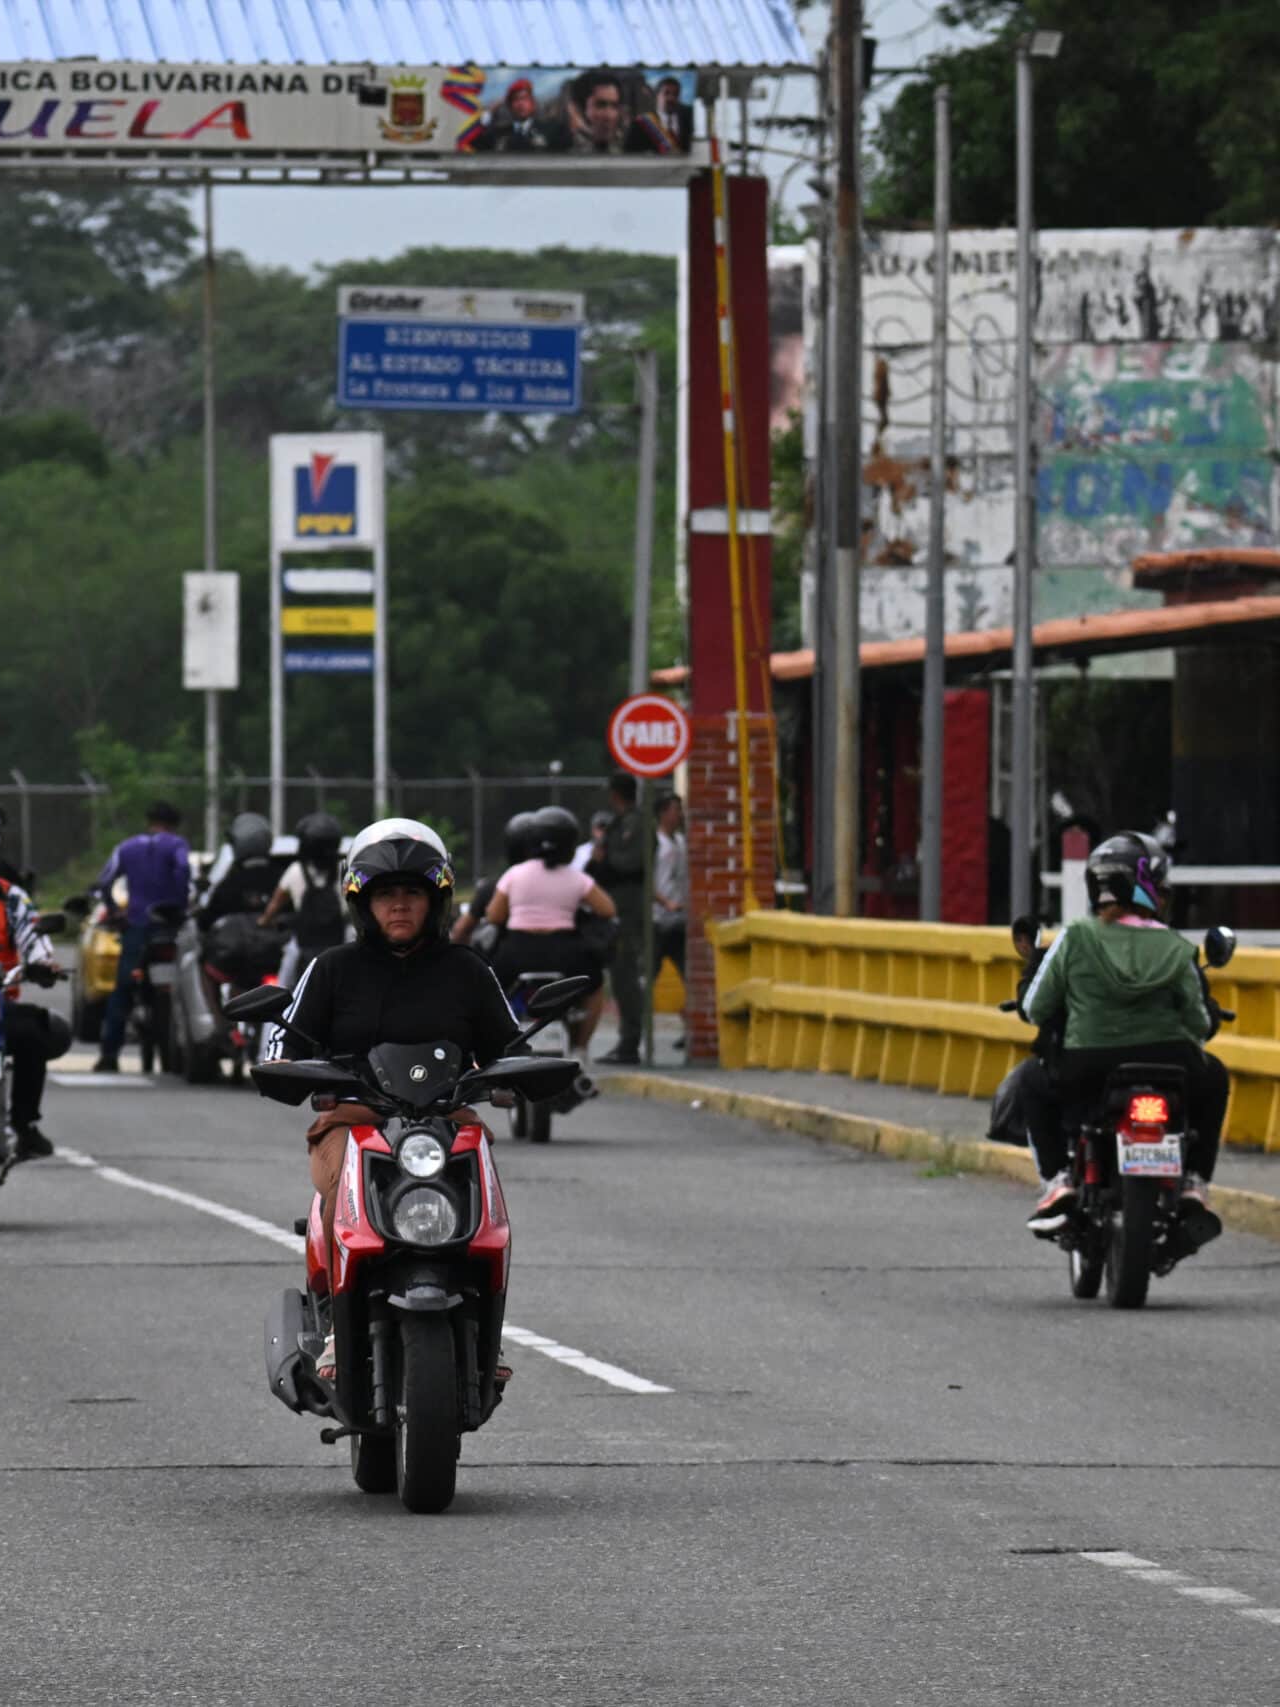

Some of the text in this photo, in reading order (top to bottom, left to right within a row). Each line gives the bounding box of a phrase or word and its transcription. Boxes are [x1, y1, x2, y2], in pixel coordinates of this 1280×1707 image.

[71, 71, 310, 94] BOLIVARIANA
[322, 73, 367, 95] DE
[384, 326, 532, 349] BIENVENIDOS
[349, 353, 377, 373] AL
[381, 354, 463, 375] ESTADO
[622, 720, 676, 748] PARE
